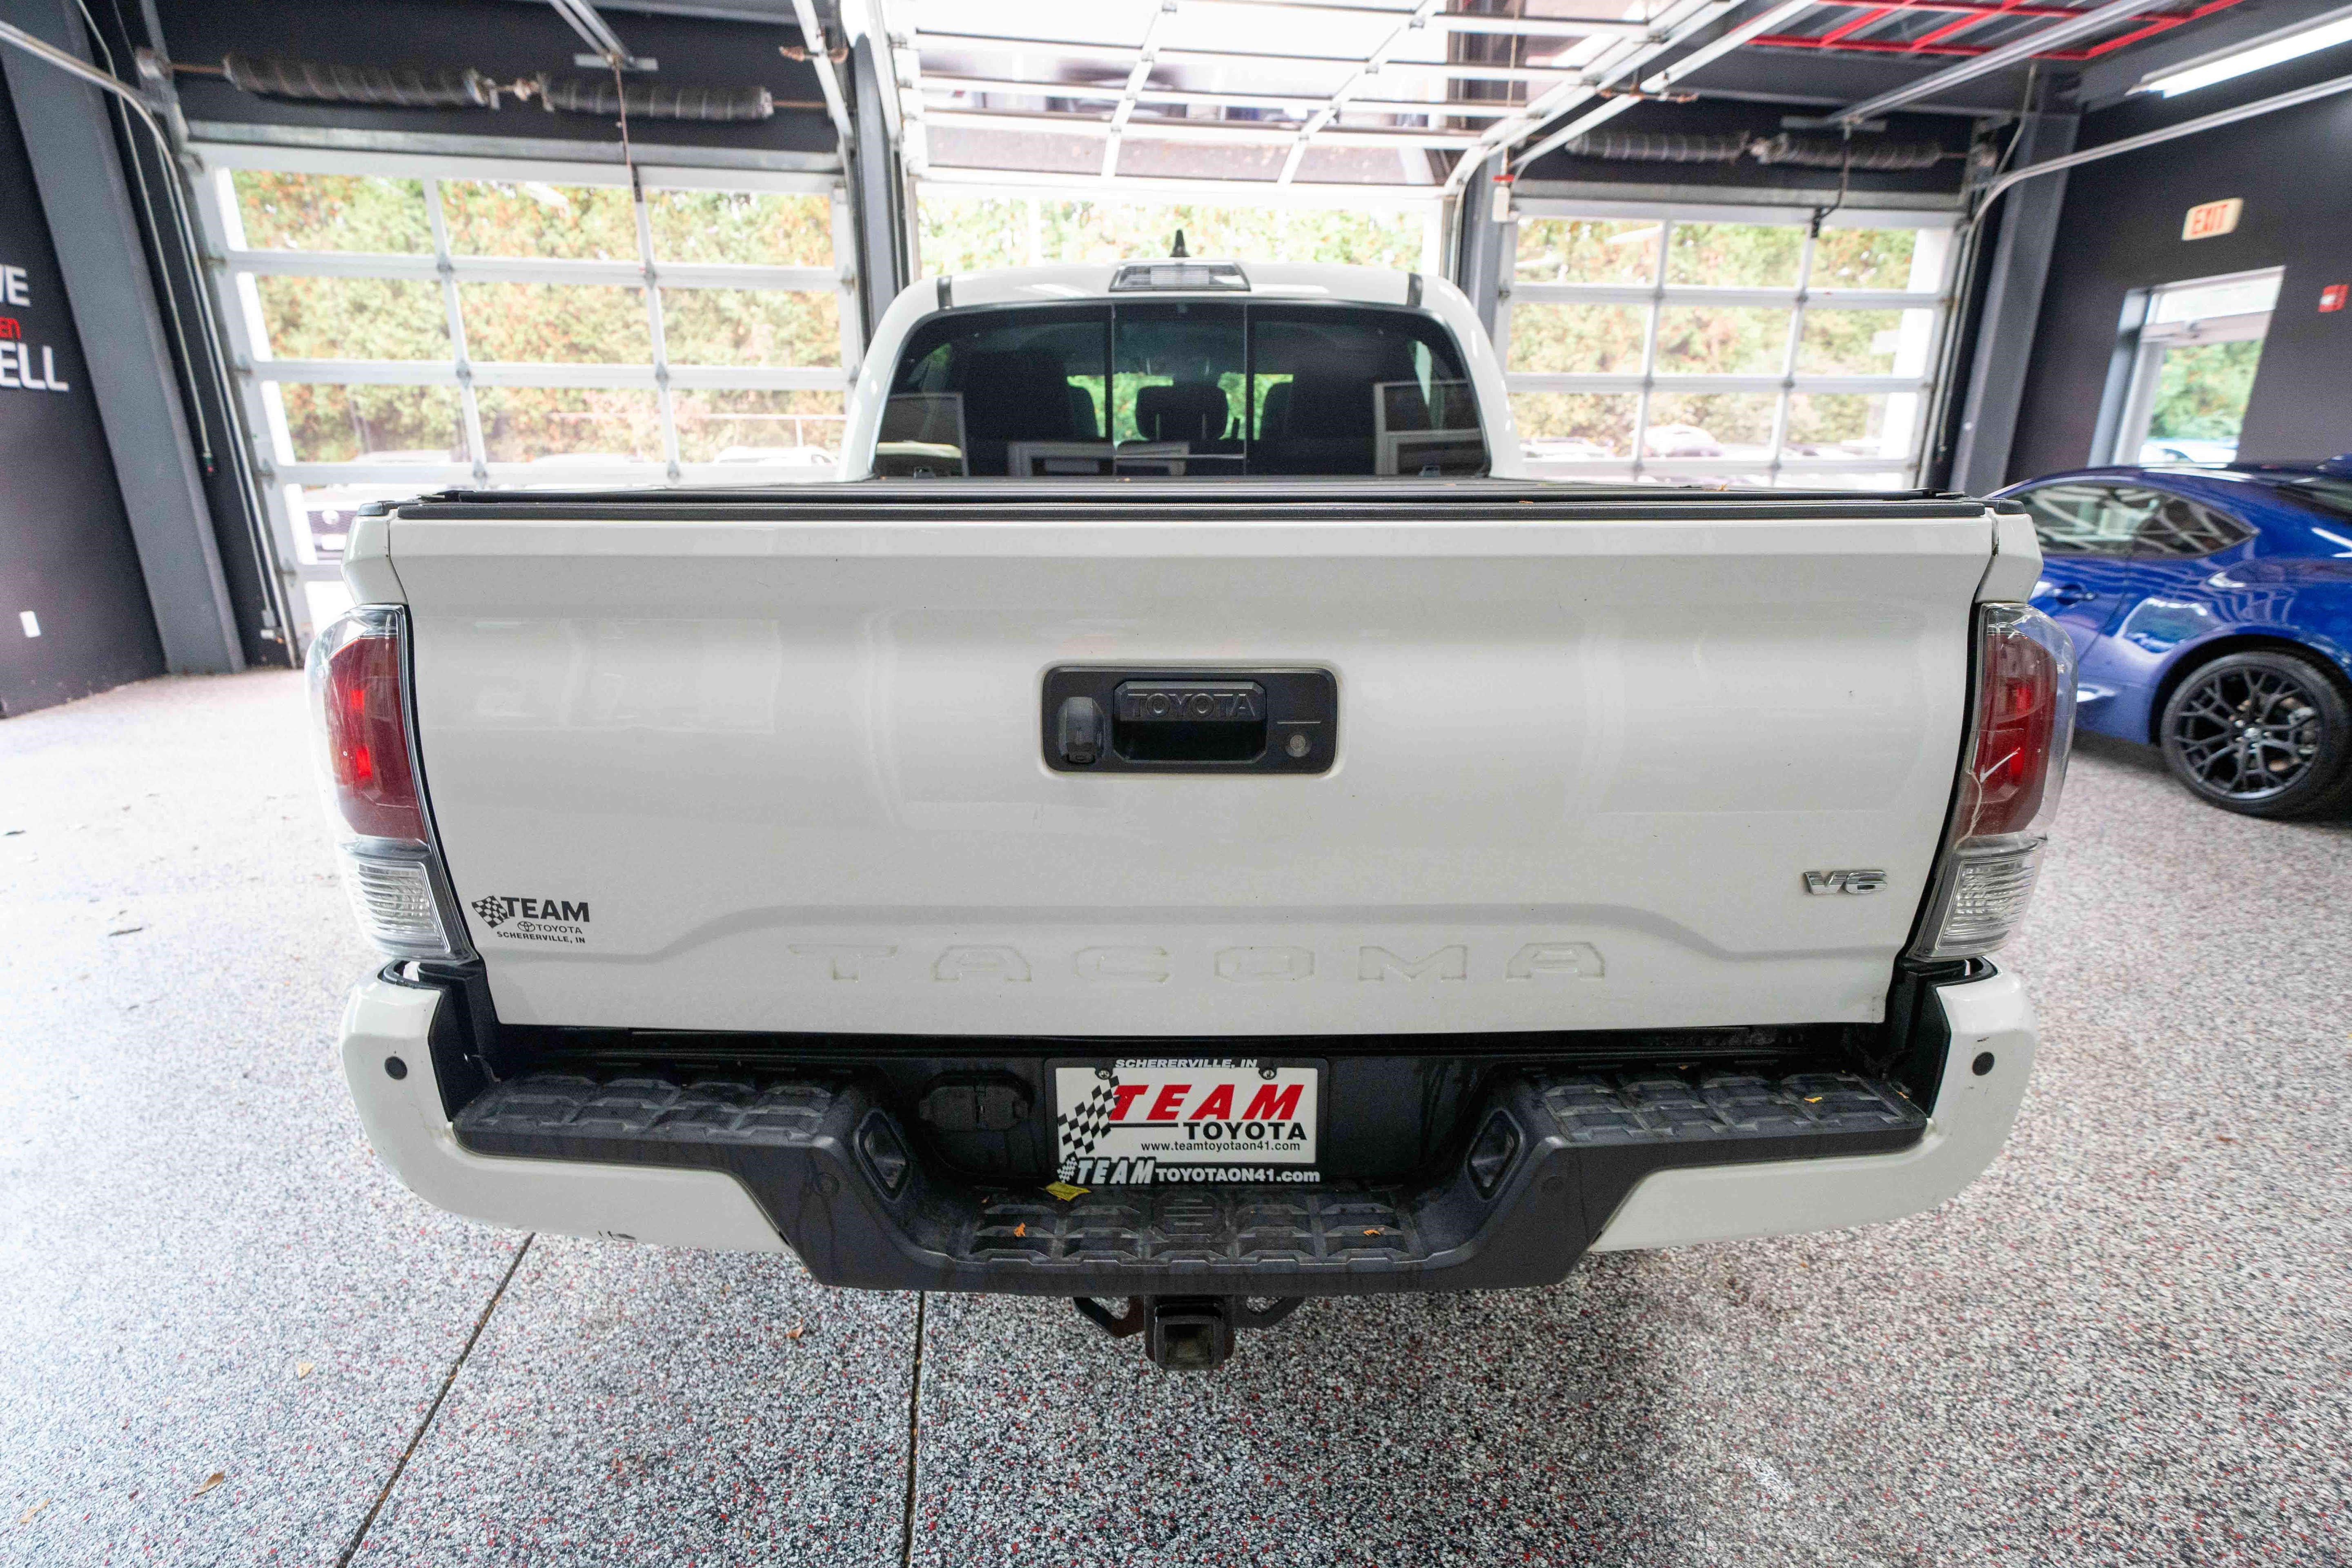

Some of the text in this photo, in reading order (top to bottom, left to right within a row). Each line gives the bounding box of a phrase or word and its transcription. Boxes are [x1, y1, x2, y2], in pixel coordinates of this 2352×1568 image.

[2191, 204, 2228, 234] EXIT
[1127, 693, 1255, 717] TOYOTA
[1803, 871, 1888, 894] V6
[500, 896, 590, 922] TEAM
[497, 931, 573, 944] SCHERERVILLE,
[536, 924, 582, 934] TOYOTA
[787, 942, 1605, 981] TACOMA
[1115, 1059, 1258, 1069] SCHERERVILLE, IN
[1109, 1084, 1305, 1120] TEAM
[1183, 1122, 1307, 1140] TOYOTA
[1141, 1141, 1301, 1152] www.teamtoyotaon41.com
